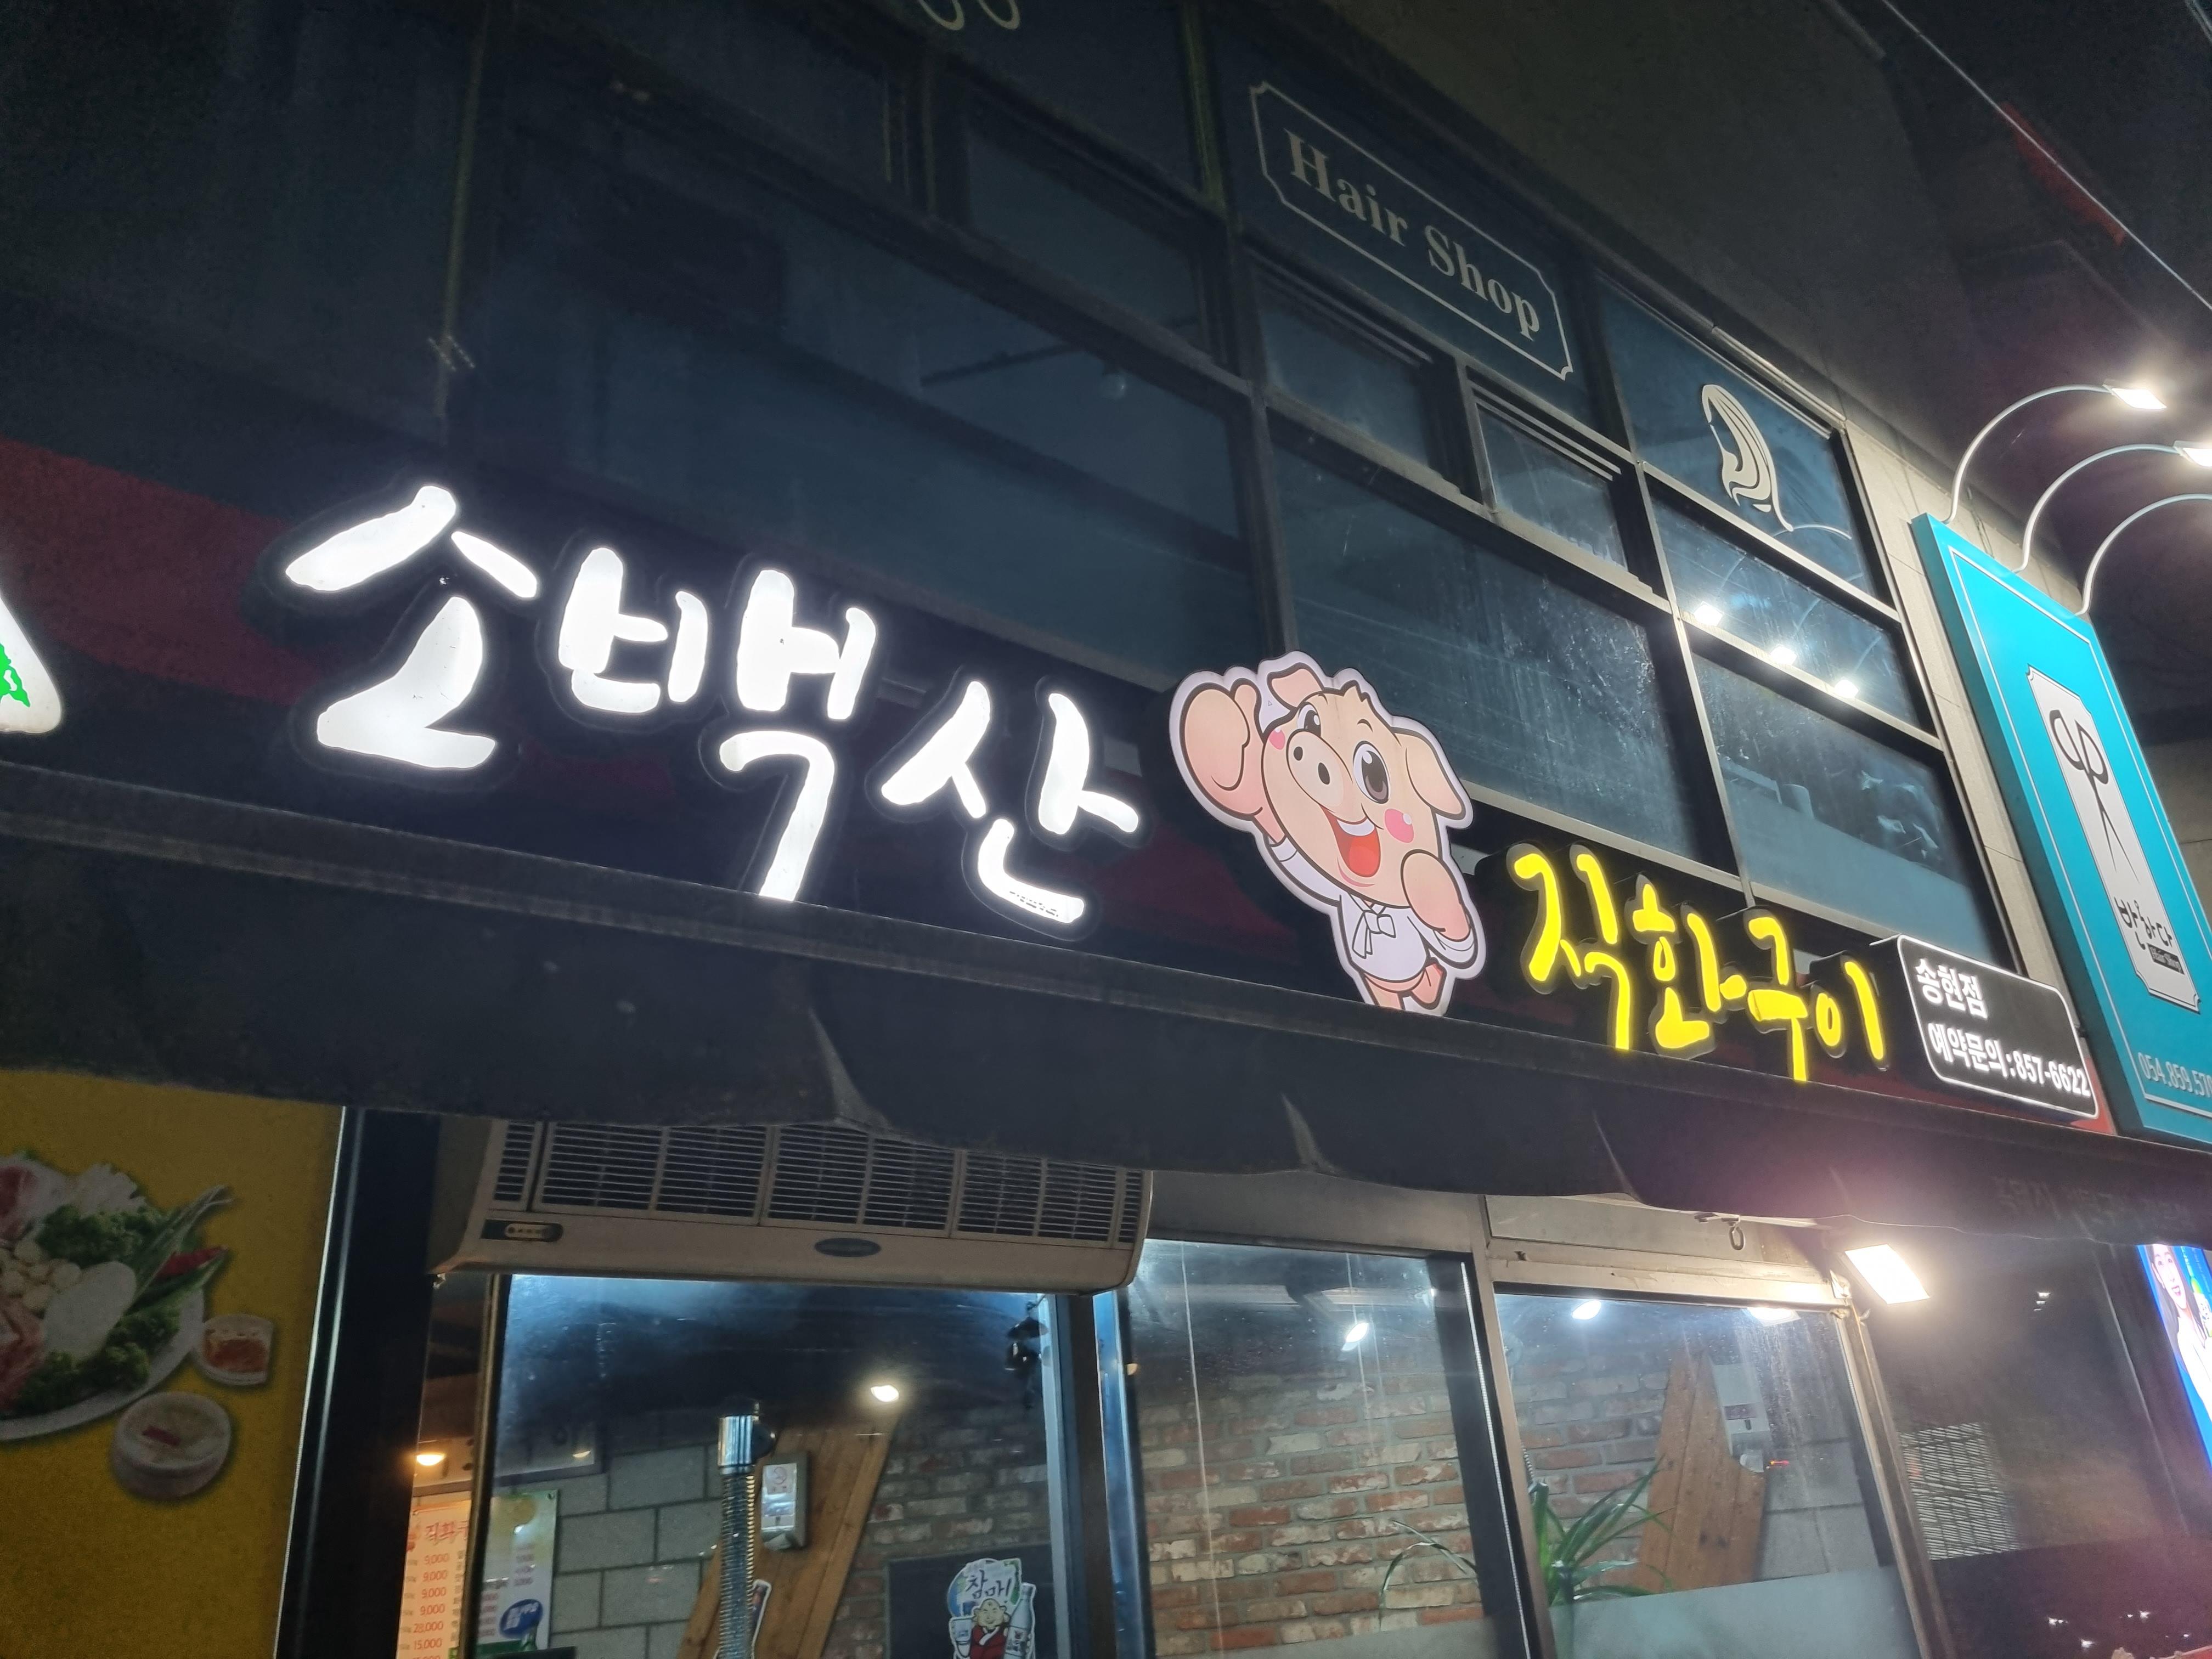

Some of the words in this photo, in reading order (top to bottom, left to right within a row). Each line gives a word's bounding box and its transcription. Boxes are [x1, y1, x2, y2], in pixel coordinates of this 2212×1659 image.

[1284, 128, 1408, 246] Hair
[1425, 224, 1541, 341] Shop
[285, 485, 1139, 924] 소백산
[1514, 853, 1885, 1082] 직화구이
[2114, 896, 2172, 950] 반하다
[1915, 958, 1988, 1019] 송현점
[1928, 1023, 2091, 1097] 예약문의:857-6622
